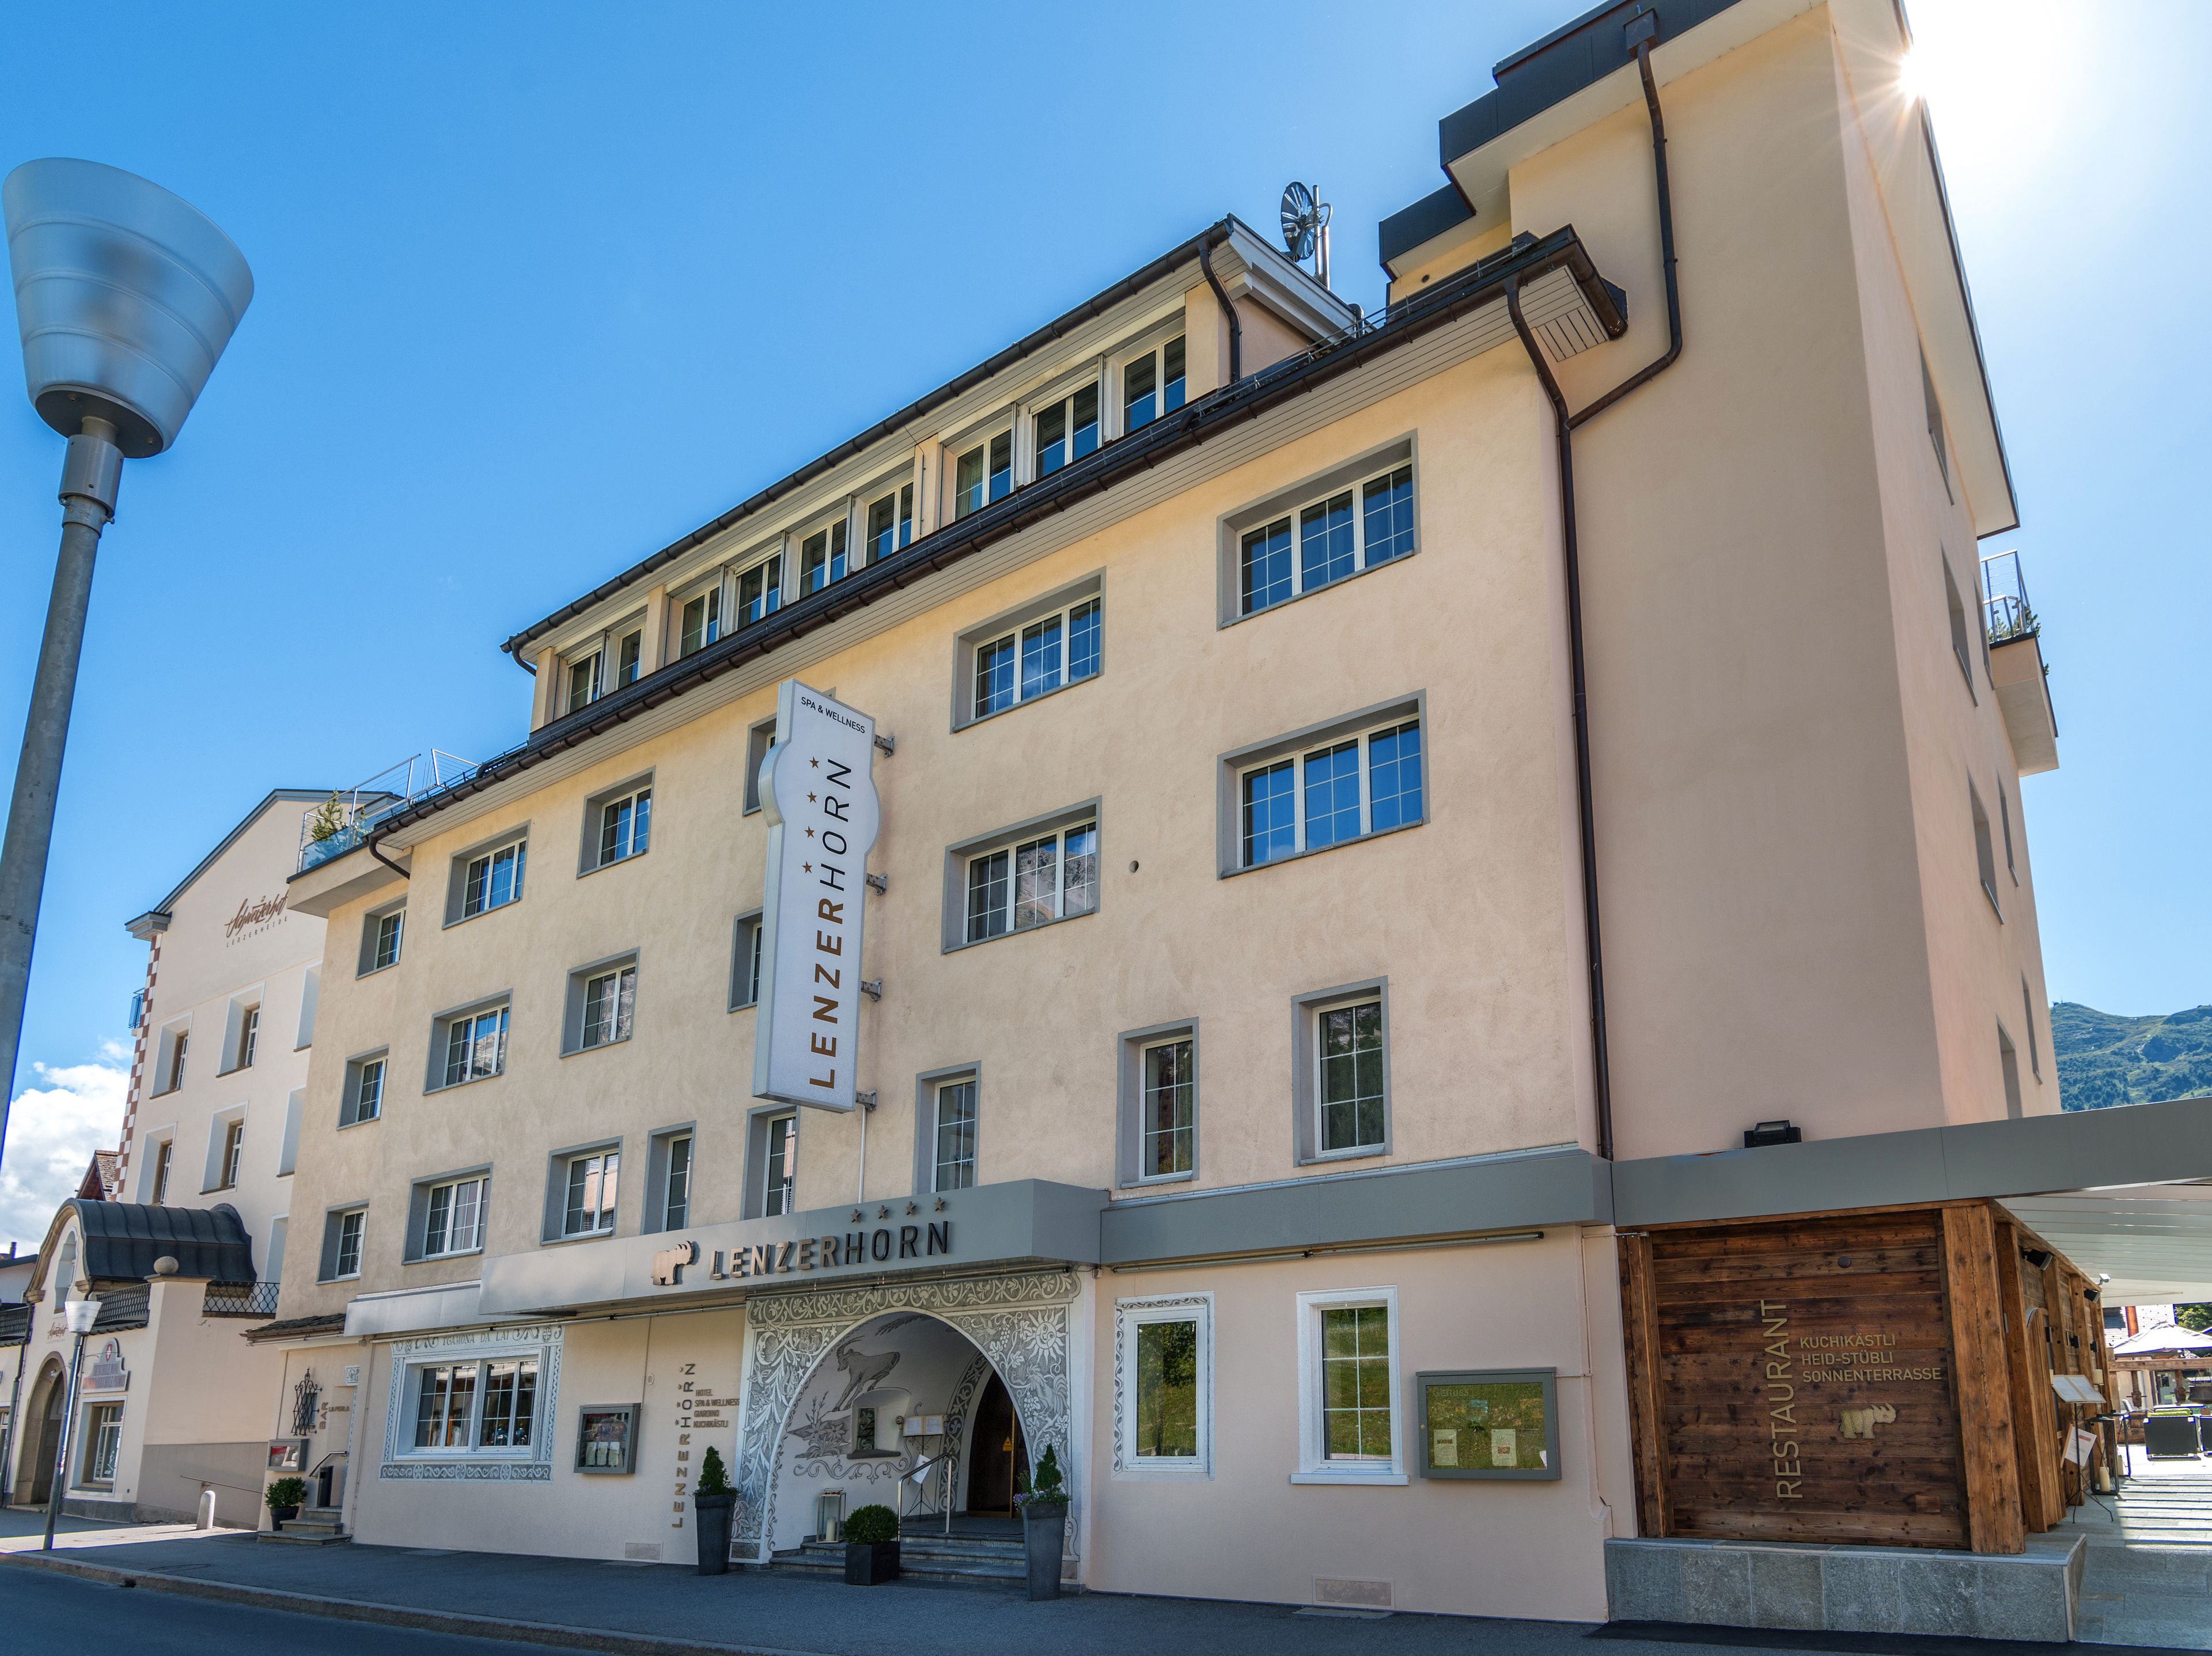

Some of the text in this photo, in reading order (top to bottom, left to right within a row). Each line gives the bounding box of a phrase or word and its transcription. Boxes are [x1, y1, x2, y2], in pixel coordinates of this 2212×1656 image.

[801, 696, 866, 734] SPA & WELLNESS
[809, 759, 852, 1089] LENZERHORN
[709, 1220, 949, 1280] LENZERHORN
[480, 1332, 490, 1343] DA
[495, 1330, 509, 1342] LAI
[1800, 1332, 1896, 1349] KUCHIKÄSTLI
[1801, 1350, 1893, 1366] HEID-STÜBLI
[1802, 1367, 1942, 1383] SONNENTERRASSE
[695, 1388, 714, 1397] HOTEL
[1760, 1299, 1803, 1498] RESTAURANT
[694, 1398, 740, 1407] SPA & WELLNESS
[319, 1401, 329, 1430] BAR
[694, 1409, 719, 1418] GIARDINO
[672, 1363, 696, 1528] LENZERHORN
